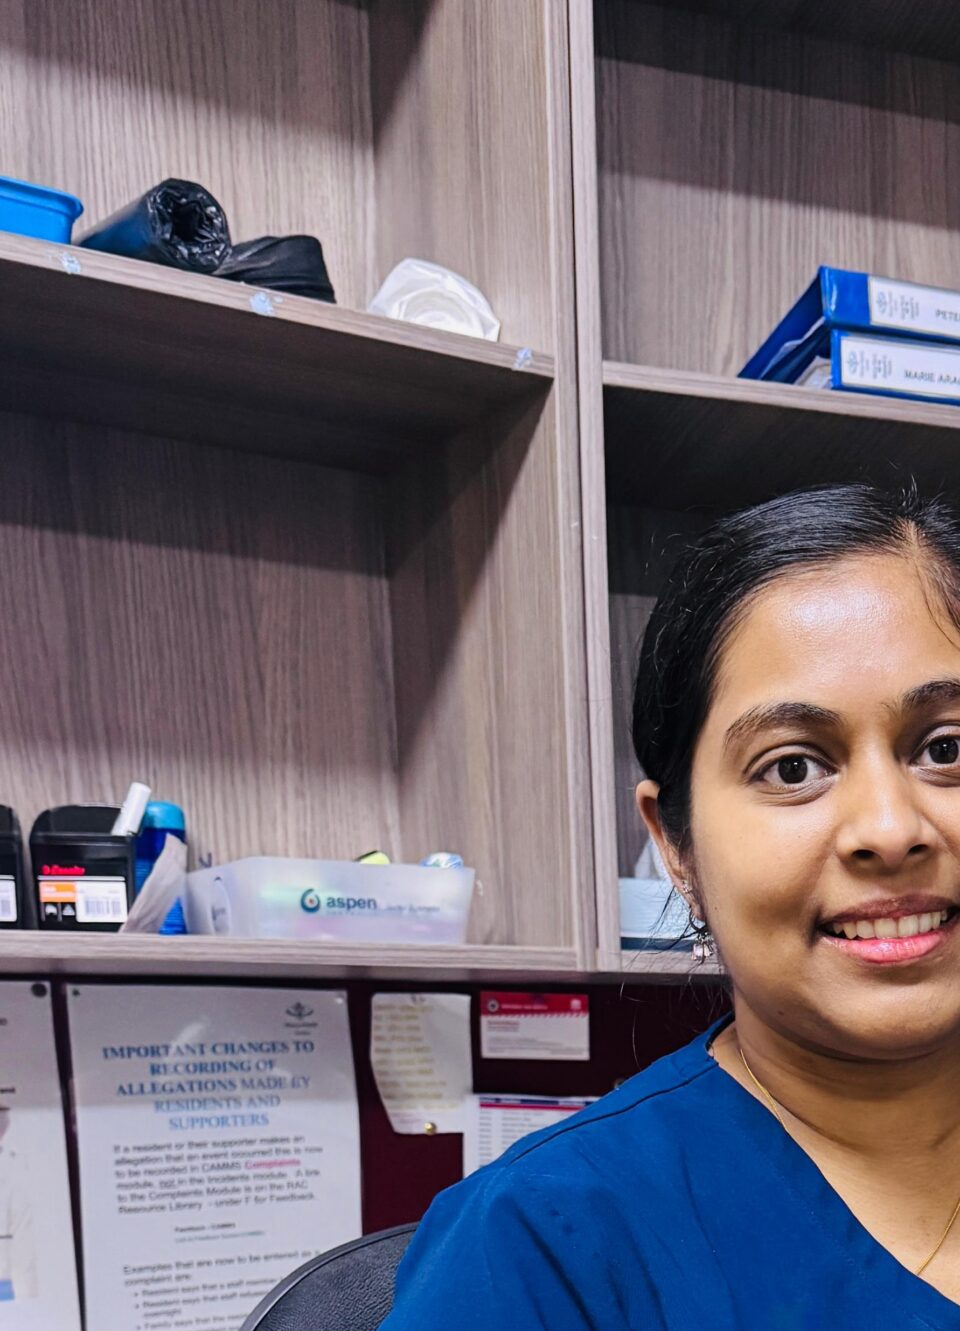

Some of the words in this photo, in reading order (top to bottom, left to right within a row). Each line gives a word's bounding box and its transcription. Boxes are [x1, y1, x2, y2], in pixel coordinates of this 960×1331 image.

[904, 370, 935, 382] MARIE
[326, 896, 377, 911] aspen
[102, 1043, 206, 1060] IMPORTANT
[211, 1041, 289, 1056] CHANGES
[292, 1040, 315, 1054] TO
[150, 1061, 251, 1076] RECORDING
[256, 1059, 277, 1071] OF
[117, 1079, 237, 1096] ALLEGATIONS
[241, 1076, 286, 1090] MADE
[291, 1076, 310, 1089] BY
[154, 1096, 242, 1113] RESIDENTS
[246, 1094, 281, 1108] AND
[168, 1113, 270, 1130] SUPPORTERS
[133, 1142, 172, 1152] resident
[187, 1140, 209, 1149] their
[212, 1138, 257, 1150] supporter
[260, 1136, 290, 1145] makes
[115, 1155, 162, 1167] allegation
[165, 1152, 184, 1162] that
[202, 1151, 228, 1160] event
[231, 1148, 273, 1159] occurred
[275, 1147, 291, 1155] this
[128, 1168, 140, 1177] be
[143, 1165, 187, 1176] recorded
[244, 1158, 301, 1170] Complaints
[189, 1176, 204, 1185] the
[207, 1173, 250, 1184] Incidents
[130, 1192, 146, 1202] the
[148, 1189, 203, 1201] Complaints
[206, 1185, 241, 1196] Module
[269, 1182, 284, 1192] the
[118, 1204, 166, 1214] Resource
[169, 1201, 202, 1213] Library
[214, 1197, 242, 1207] under
[123, 1262, 173, 1275] Examples
[175, 1259, 194, 1270] that
[196, 1259, 213, 1268] are
[215, 1257, 235, 1266] now
[249, 1254, 261, 1263] be
[124, 1274, 173, 1287] complaint
